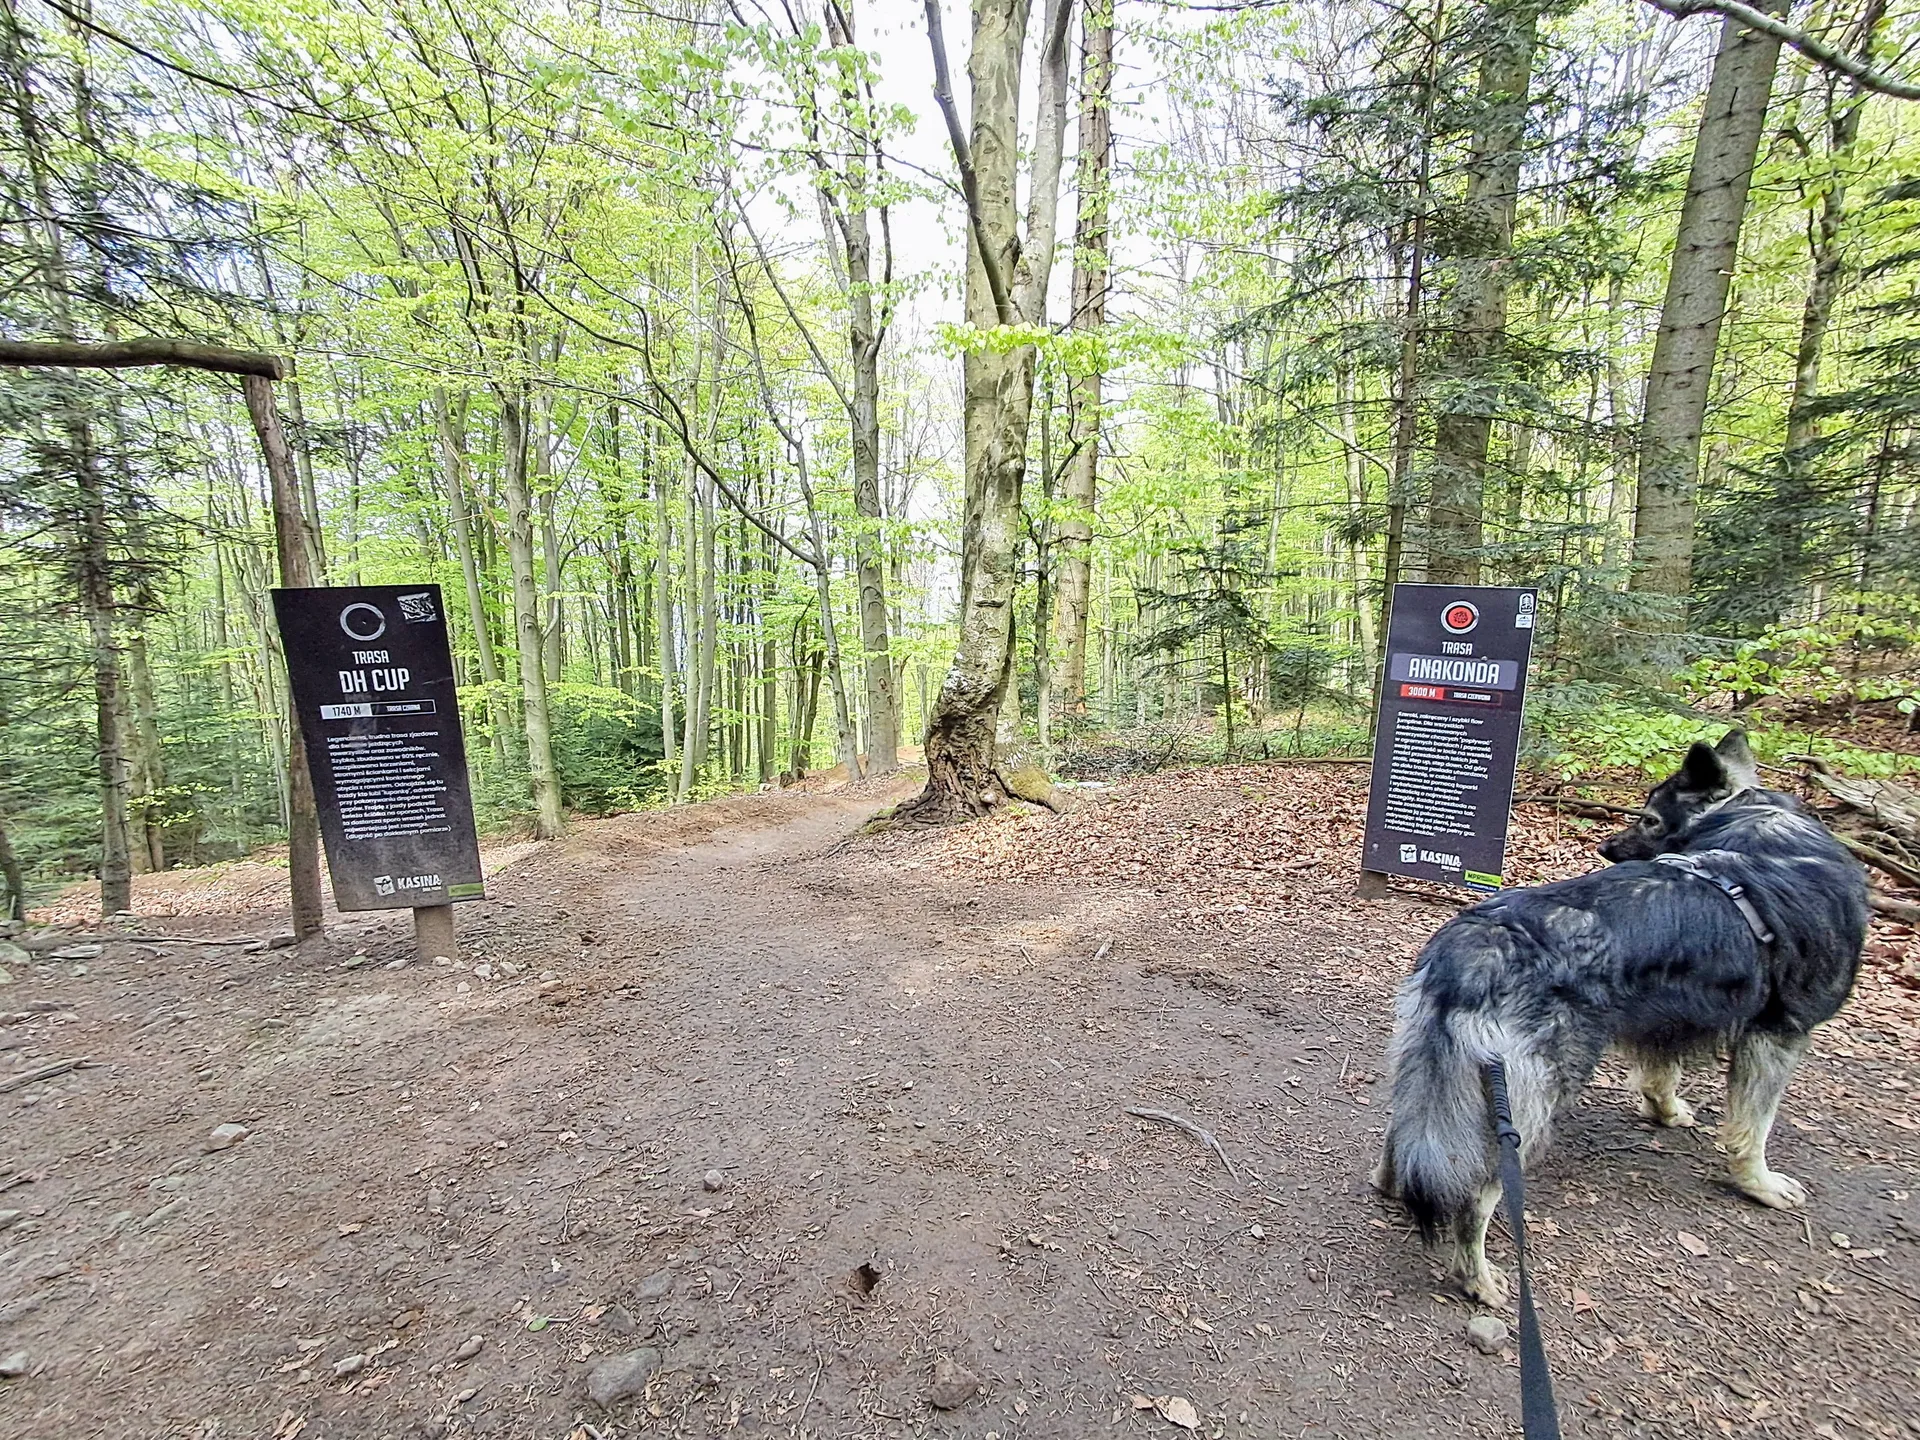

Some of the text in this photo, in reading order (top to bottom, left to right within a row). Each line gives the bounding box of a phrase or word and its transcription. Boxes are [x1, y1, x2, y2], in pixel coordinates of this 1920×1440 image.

[1442, 642, 1472, 655] TRASA
[352, 650, 390, 664] TRASA
[1409, 658, 1500, 684] ANAKONDA
[339, 668, 410, 693] DH CUP
[1408, 687, 1436, 697] 3000 M
[332, 706, 361, 716] 1740 M
[1420, 850, 1460, 867] KASINA
[397, 874, 440, 889] KASINA
